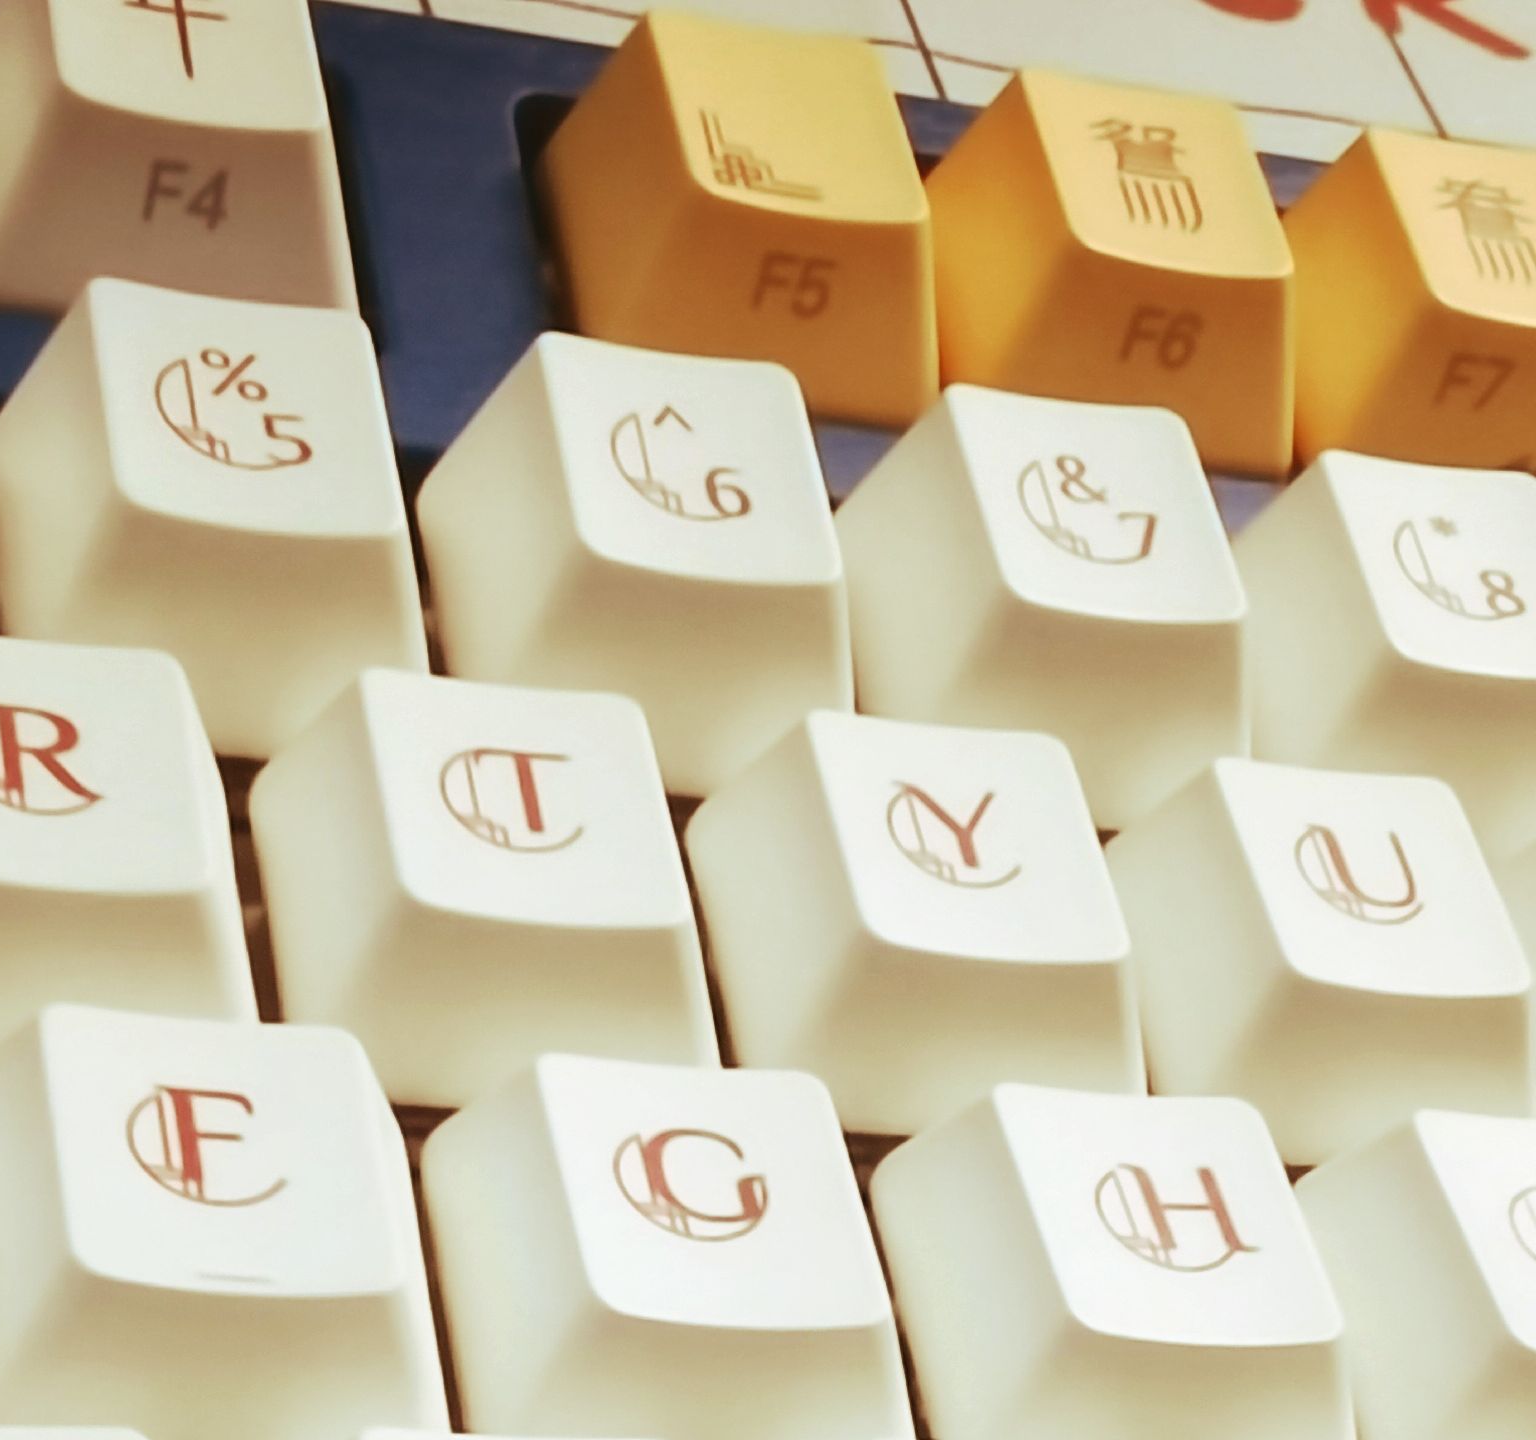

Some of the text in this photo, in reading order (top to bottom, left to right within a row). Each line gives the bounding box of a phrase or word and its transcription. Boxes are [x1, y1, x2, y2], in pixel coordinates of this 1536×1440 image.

[140, 158, 232, 232] F4
[750, 249, 838, 321] F5
[1117, 303, 1204, 371] F6
[200, 347, 270, 404] %
[1431, 351, 1517, 411] F7
[261, 412, 313, 470] 5
[704, 466, 751, 520] 6
[1055, 454, 1108, 504] &
[1116, 511, 1159, 562] 7
[1477, 570, 1527, 619] 8
[468, 747, 572, 835] T
[891, 780, 997, 869] Y
[1304, 822, 1421, 910] U
[151, 1083, 257, 1197] F
[640, 1126, 770, 1224] G
[1115, 1162, 1263, 1254] H
